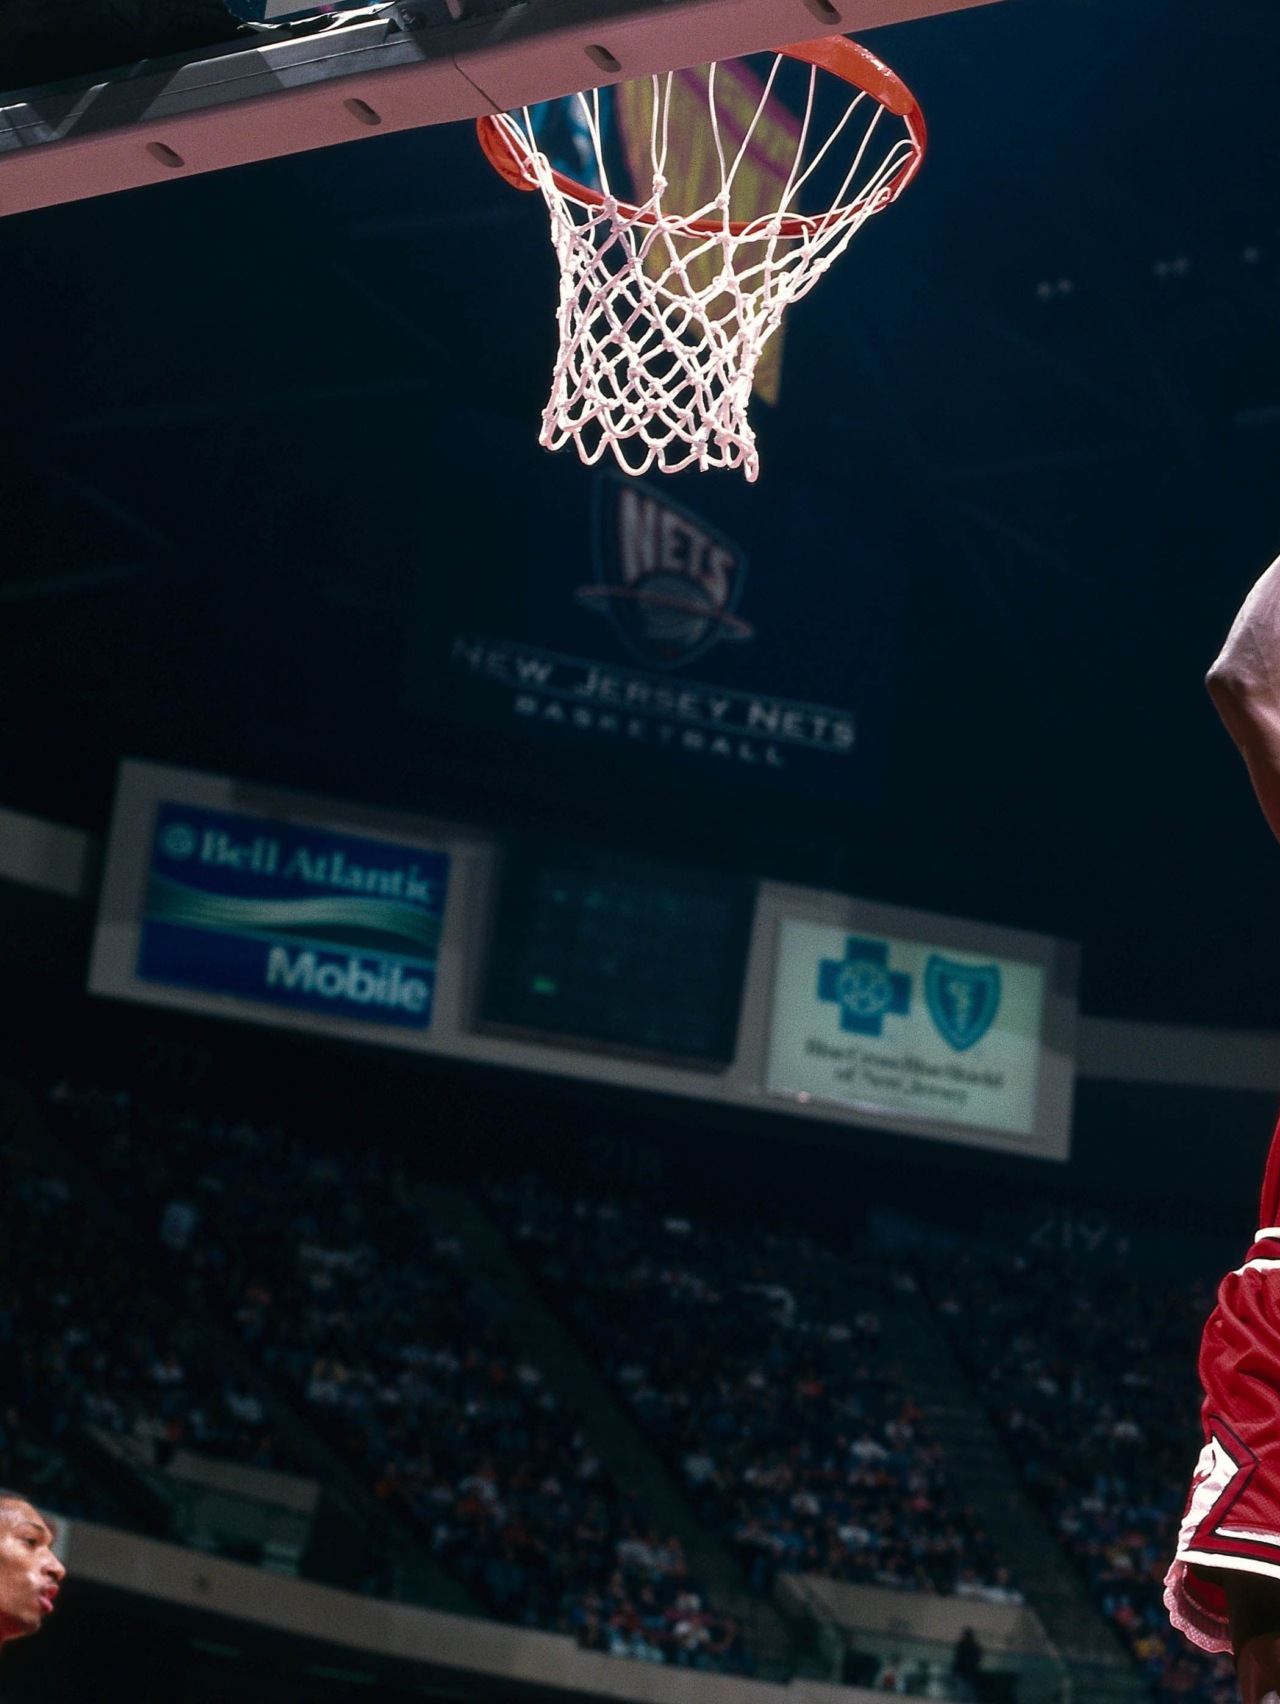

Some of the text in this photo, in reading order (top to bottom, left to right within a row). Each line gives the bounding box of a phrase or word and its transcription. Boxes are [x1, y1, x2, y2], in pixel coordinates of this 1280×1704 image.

[618, 484, 738, 610] NETS
[451, 634, 856, 751] NEW JERSEY NETS
[514, 694, 785, 768] BASKETBALL
[201, 828, 432, 903] Bell Atlantic
[265, 945, 430, 1014] Mobile
